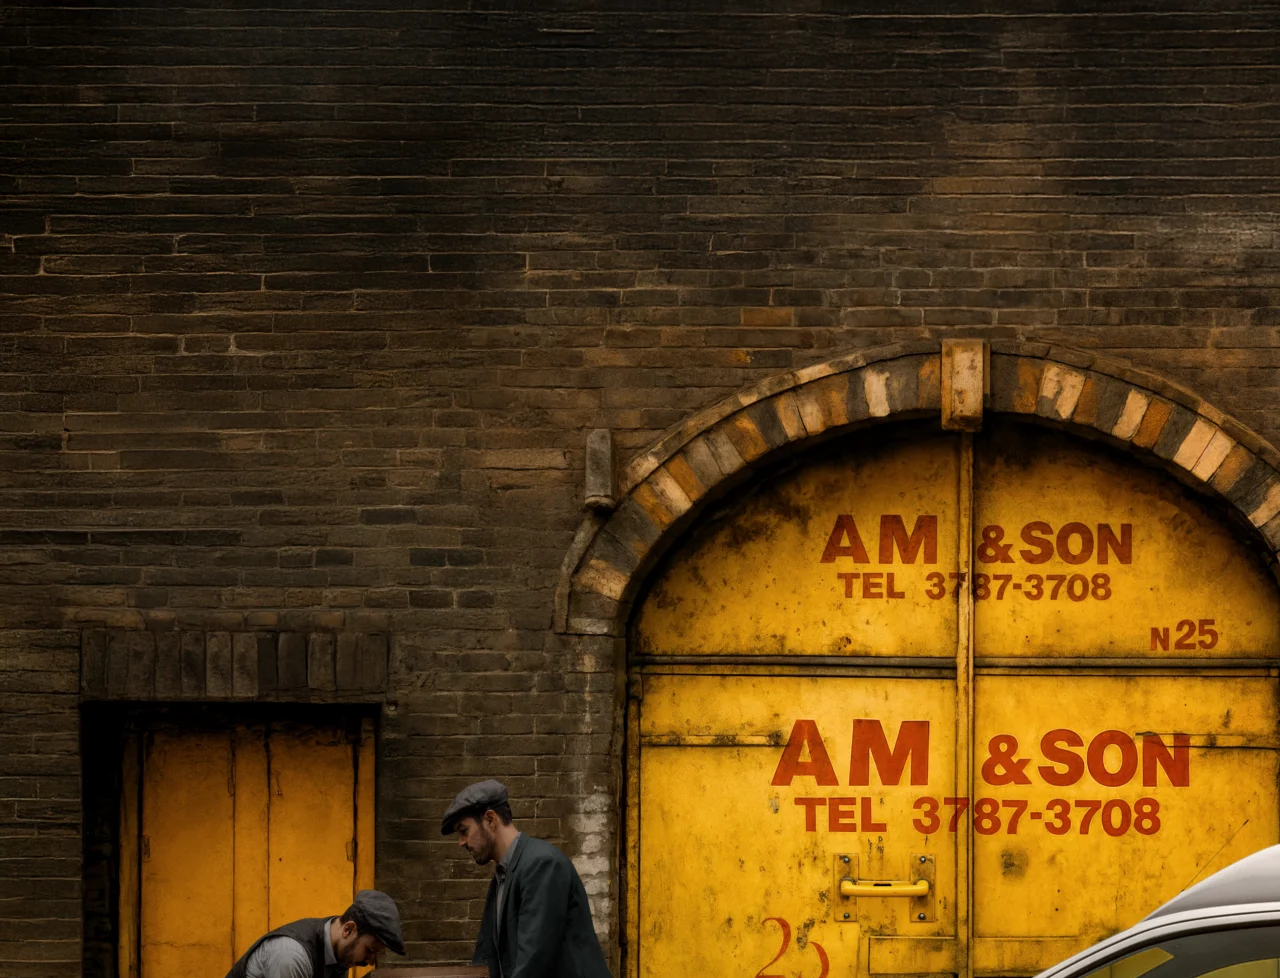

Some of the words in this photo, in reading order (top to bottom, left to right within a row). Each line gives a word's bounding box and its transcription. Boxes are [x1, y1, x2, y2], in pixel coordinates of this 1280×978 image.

[819, 513, 938, 565] AM
[837, 571, 905, 599] TEL
[925, 572, 1113, 602] 3787-3708
[771, 718, 930, 787] AM
[794, 796, 887, 833] TEL
[912, 796, 1161, 836] 3787-3708
